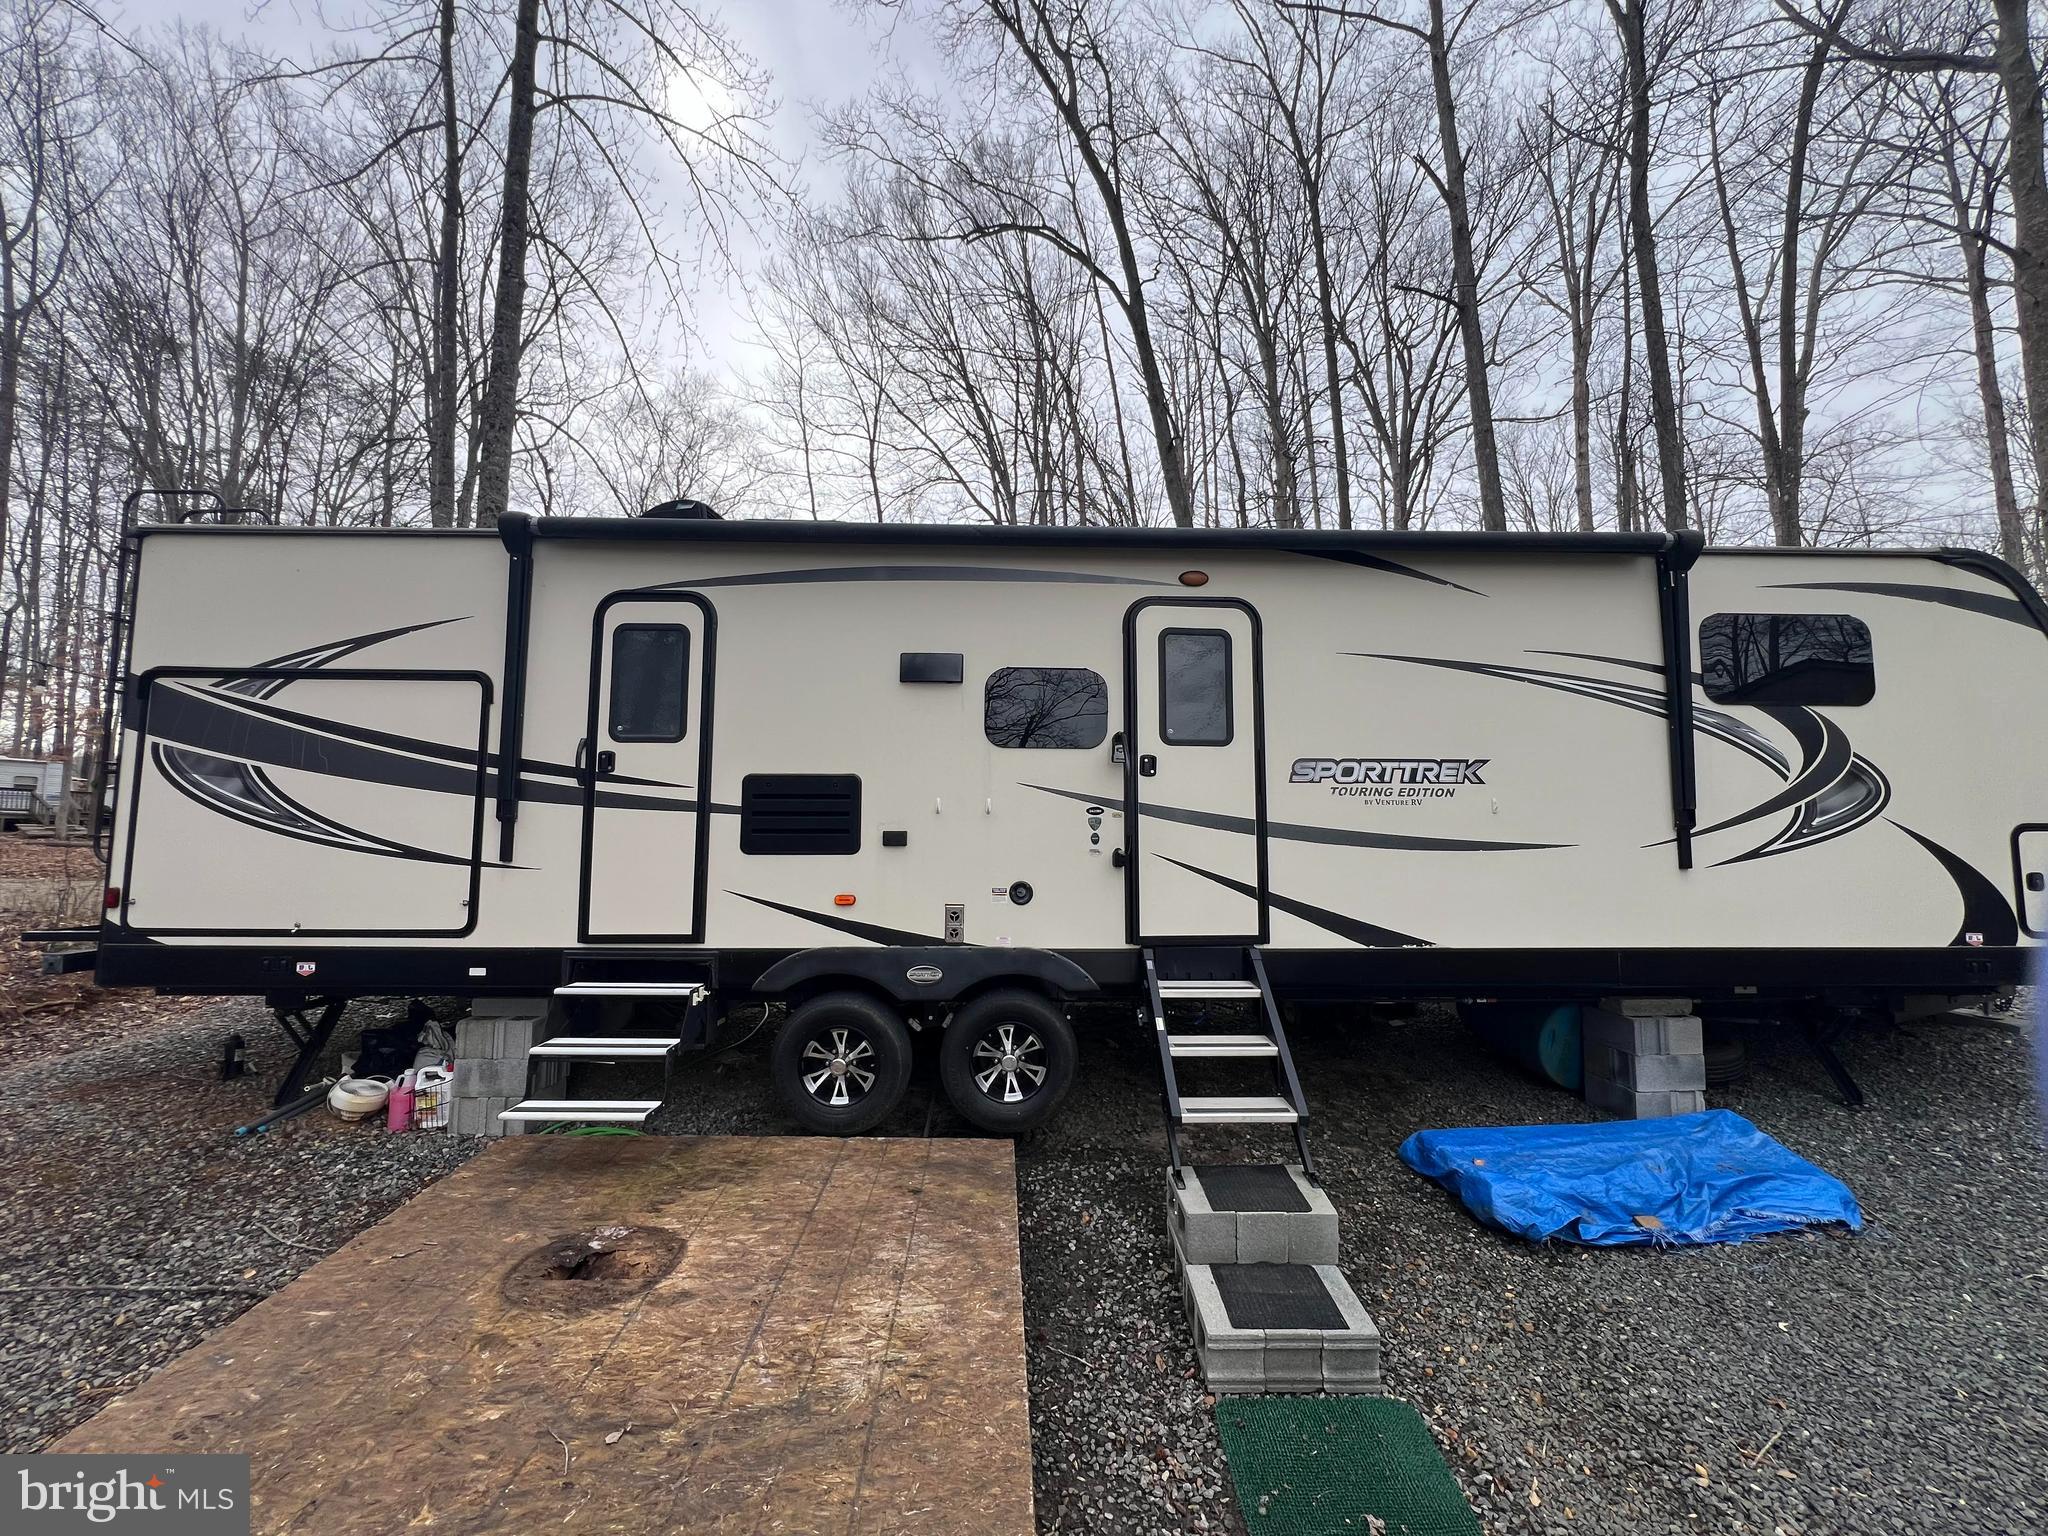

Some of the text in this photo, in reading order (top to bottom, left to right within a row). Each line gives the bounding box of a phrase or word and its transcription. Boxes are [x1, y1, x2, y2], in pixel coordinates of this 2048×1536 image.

[1289, 758, 1491, 785] SPORTTREK
[1330, 786, 1456, 798] TOURING EDITION
[1411, 798, 1423, 806] RV
